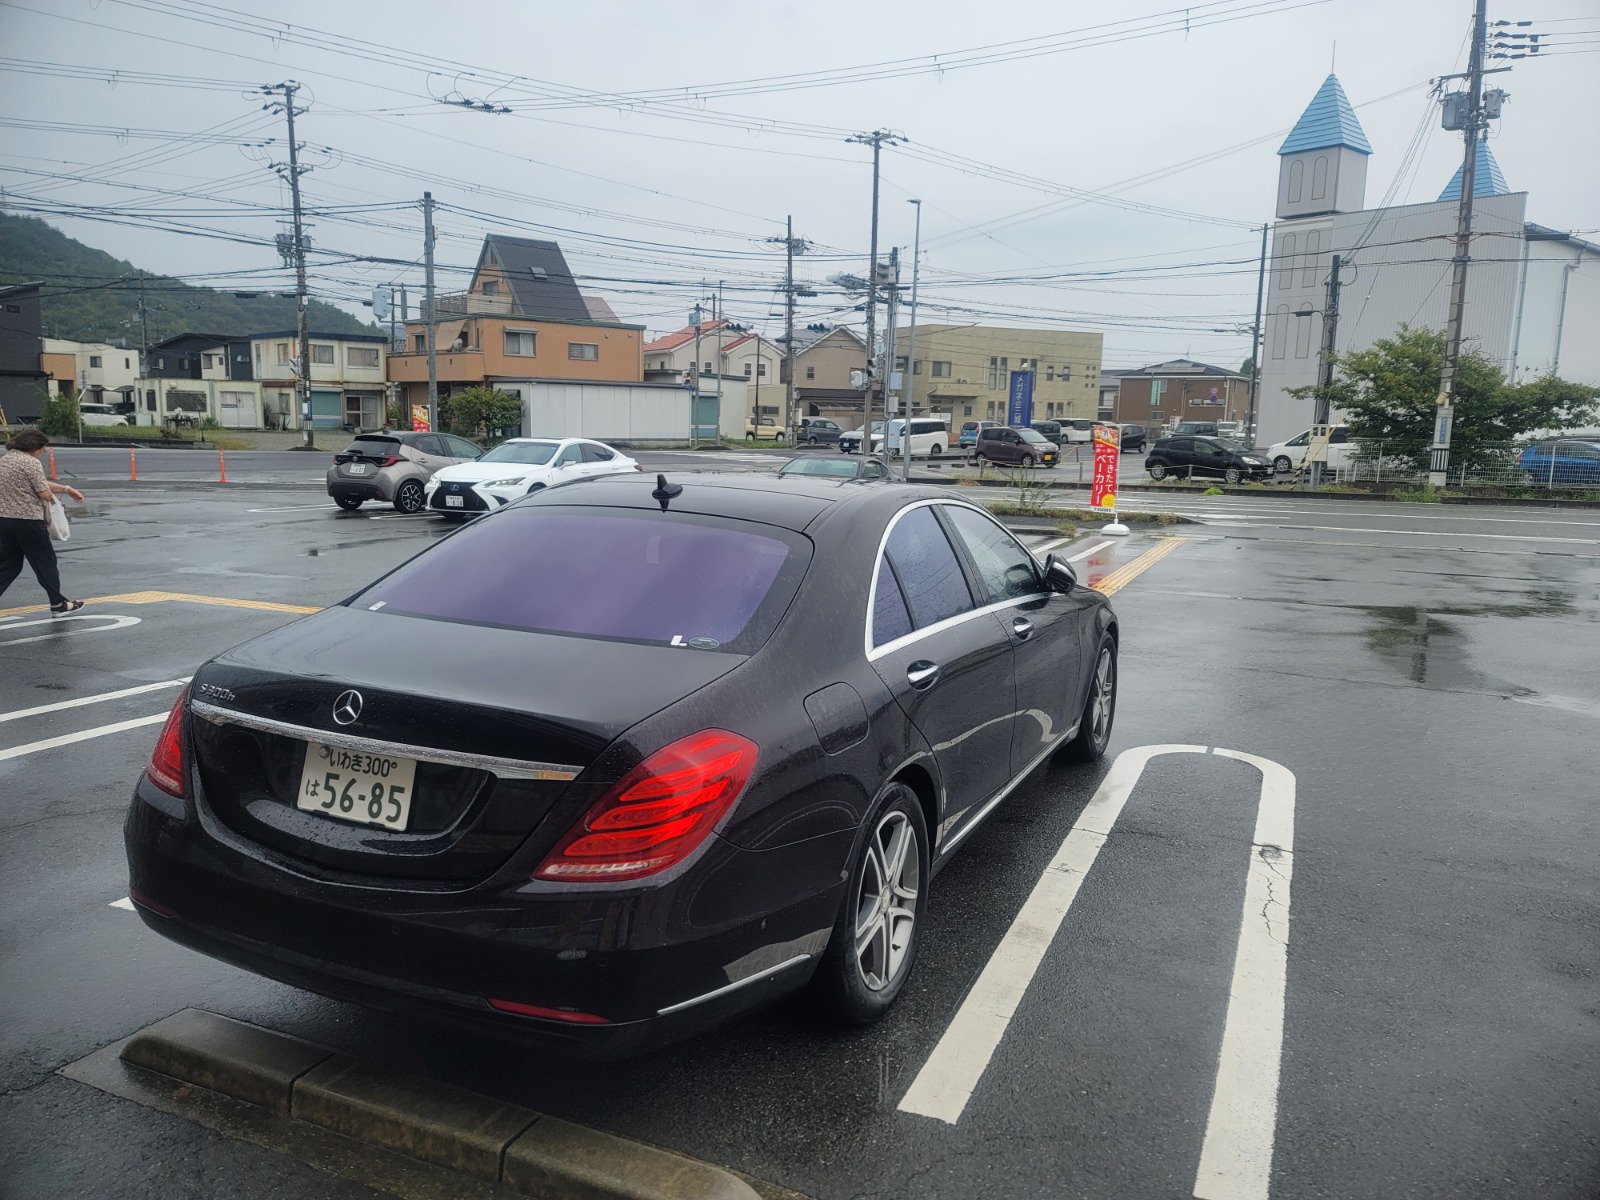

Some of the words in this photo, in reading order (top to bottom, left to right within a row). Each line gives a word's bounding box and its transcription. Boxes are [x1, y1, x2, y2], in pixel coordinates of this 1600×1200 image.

[1014, 374, 1023, 424] メガネの三城
[1095, 455, 1106, 504] ベーカリー
[1105, 455, 1115, 493] できたて
[321, 772, 405, 823] 56-85
